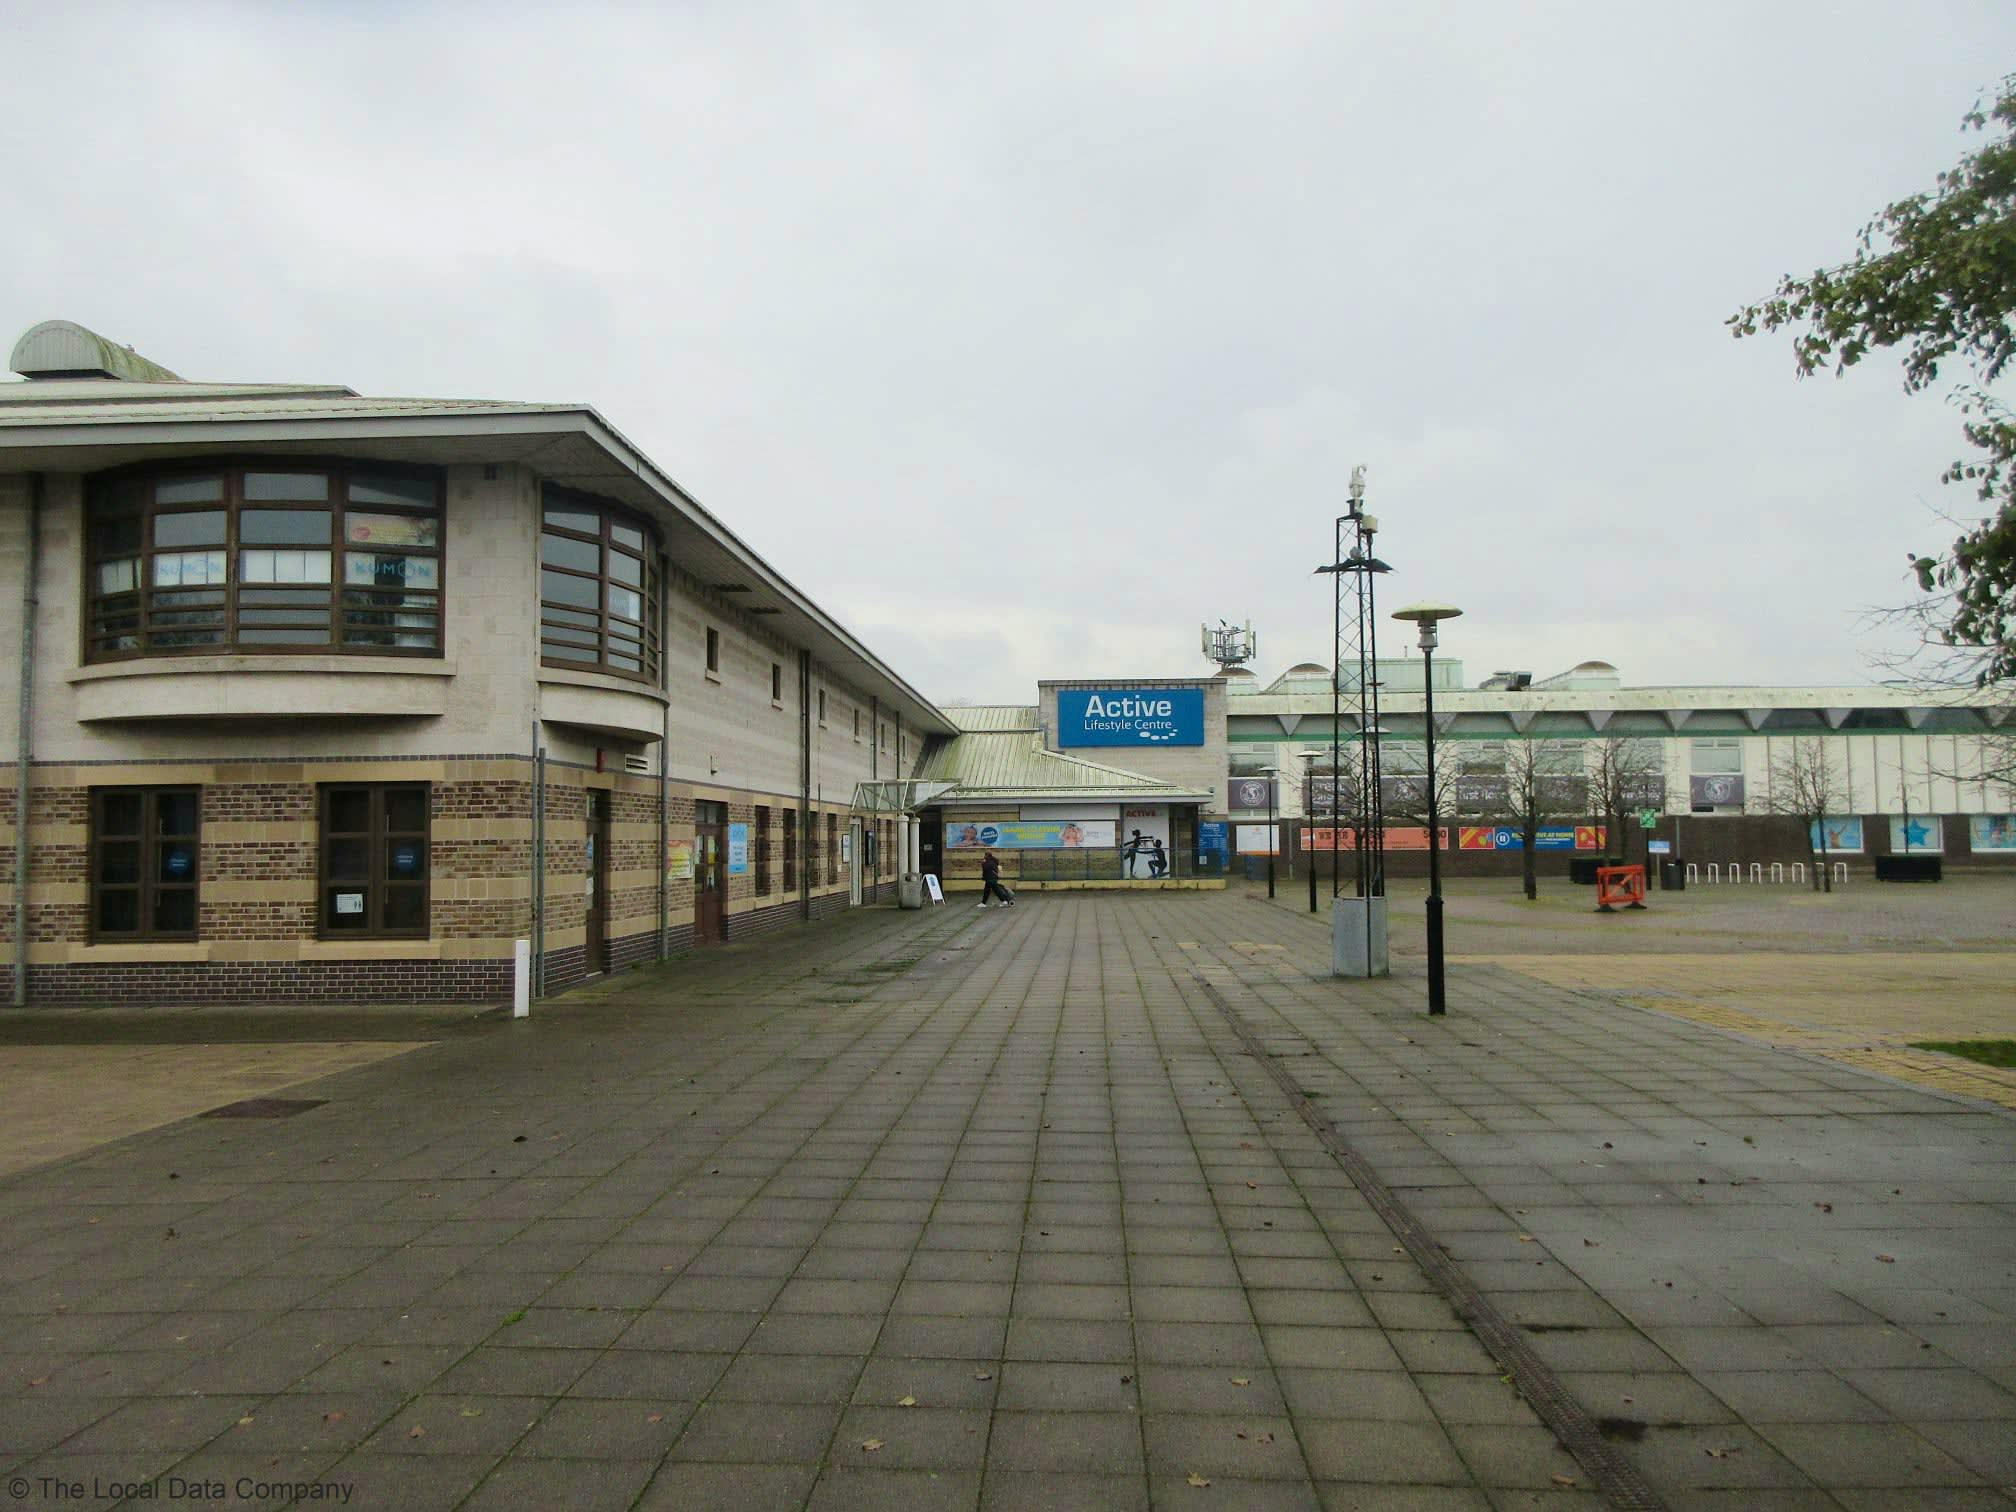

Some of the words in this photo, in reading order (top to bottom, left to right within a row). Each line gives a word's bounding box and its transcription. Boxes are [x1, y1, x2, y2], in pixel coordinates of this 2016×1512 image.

[354, 559, 431, 578] KUMON
[1084, 694, 1172, 718] Active
[1084, 719, 1131, 732] Lifestyle
[1134, 719, 1172, 730] Centre
[1126, 809, 1156, 817] ACTIVE
